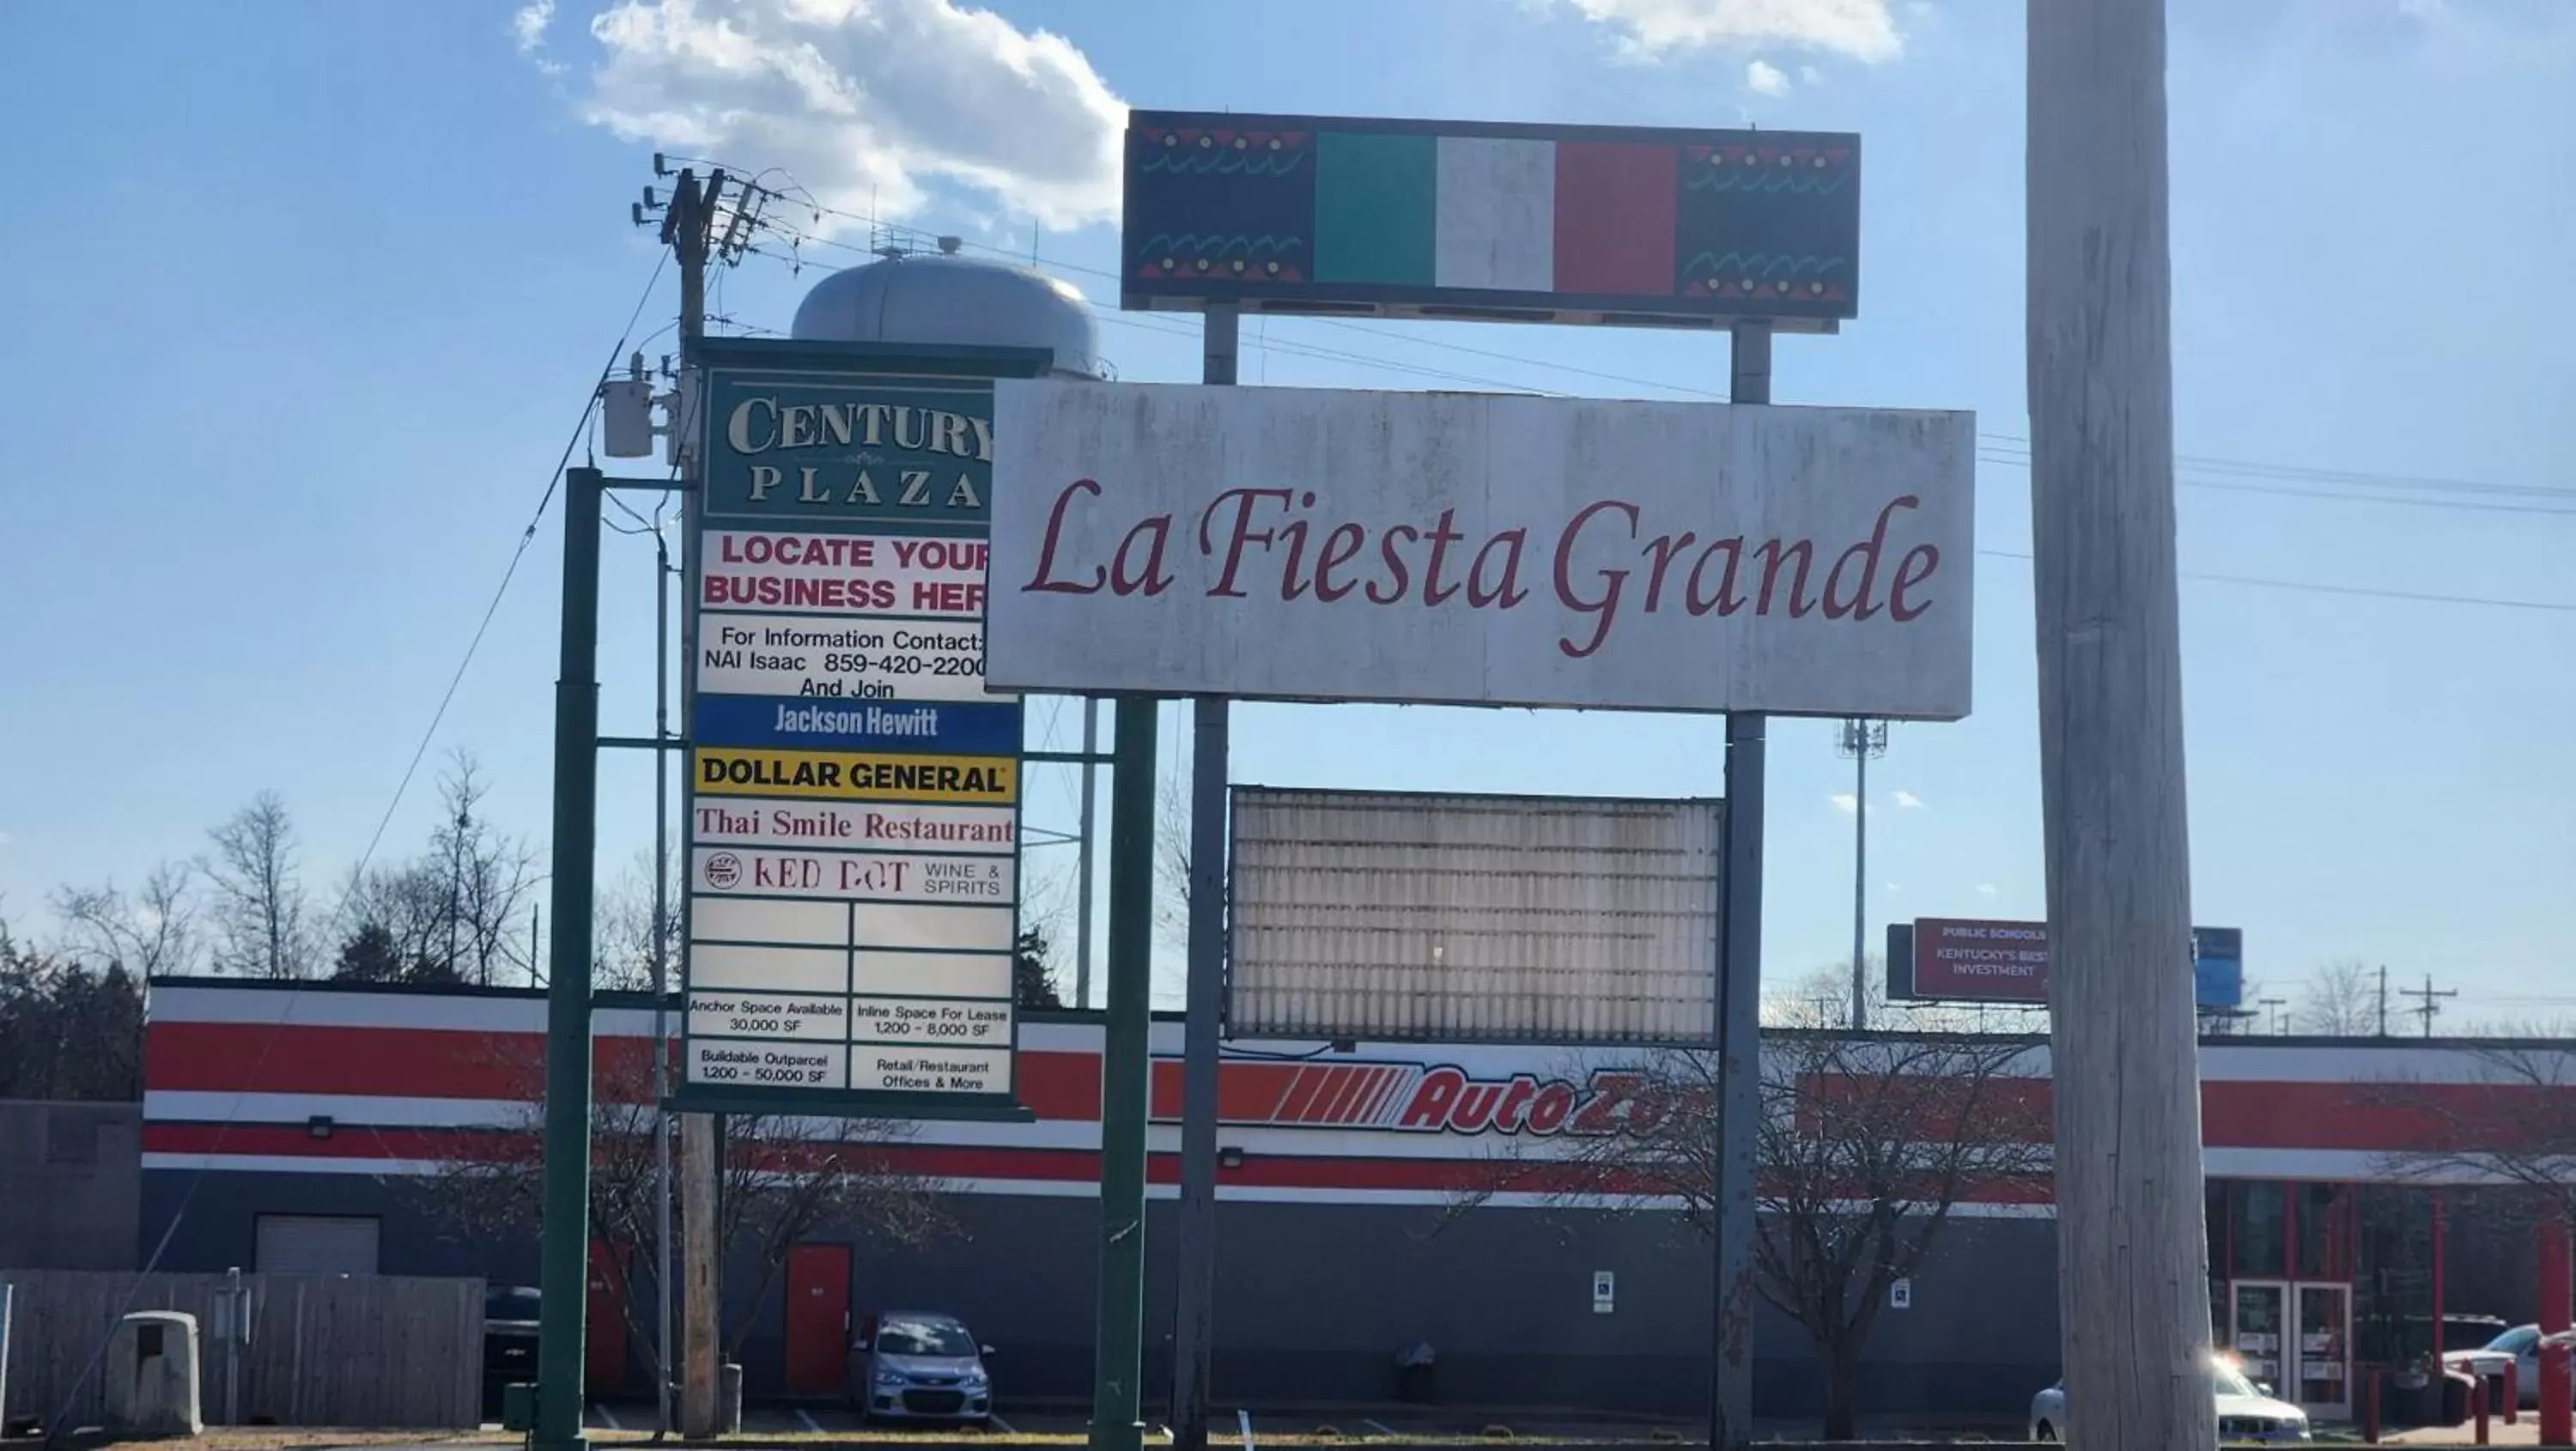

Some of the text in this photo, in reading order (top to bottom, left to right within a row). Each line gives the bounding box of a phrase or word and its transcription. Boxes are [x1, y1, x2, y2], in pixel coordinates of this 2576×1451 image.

[728, 396, 994, 461] CENTURY
[749, 466, 981, 508] PLAZA
[722, 536, 874, 568] LOCATE
[1020, 478, 1939, 658] La Fiesta Grande
[704, 574, 896, 609] BUSINESS
[721, 627, 982, 652] For Information Contact:
[705, 650, 741, 669] NAI
[750, 653, 806, 671] Isaac
[799, 678, 894, 698] And Join
[775, 704, 938, 736] Jackson Hewitt
[702, 757, 1005, 792] DOLLAR GENERAL
[696, 808, 1013, 843] Thai Smile Restaurant
[926, 863, 1000, 879] WINE &
[925, 879, 1000, 895] SPIRITS
[1942, 926, 2046, 940] PUBLIC SCHOOLS
[1936, 947, 2017, 961] KENTUCKY'S
[1952, 963, 2034, 976] INVESTMENT
[690, 999, 842, 1016] Anchor Space Available
[858, 1005, 1007, 1022] Inline Space For Lease
[730, 1017, 802, 1032] 30,000 SF
[874, 1021, 910, 1035] 1,200
[927, 1023, 967, 1037] 8,000
[972, 1024, 990, 1036] SF
[702, 1049, 829, 1067] Buildable Outparcel
[877, 1059, 989, 1073] Retail/Restaurant
[755, 1067, 803, 1083] 50,000
[808, 1070, 826, 1083] SF
[883, 1075, 983, 1090] Offices & More
